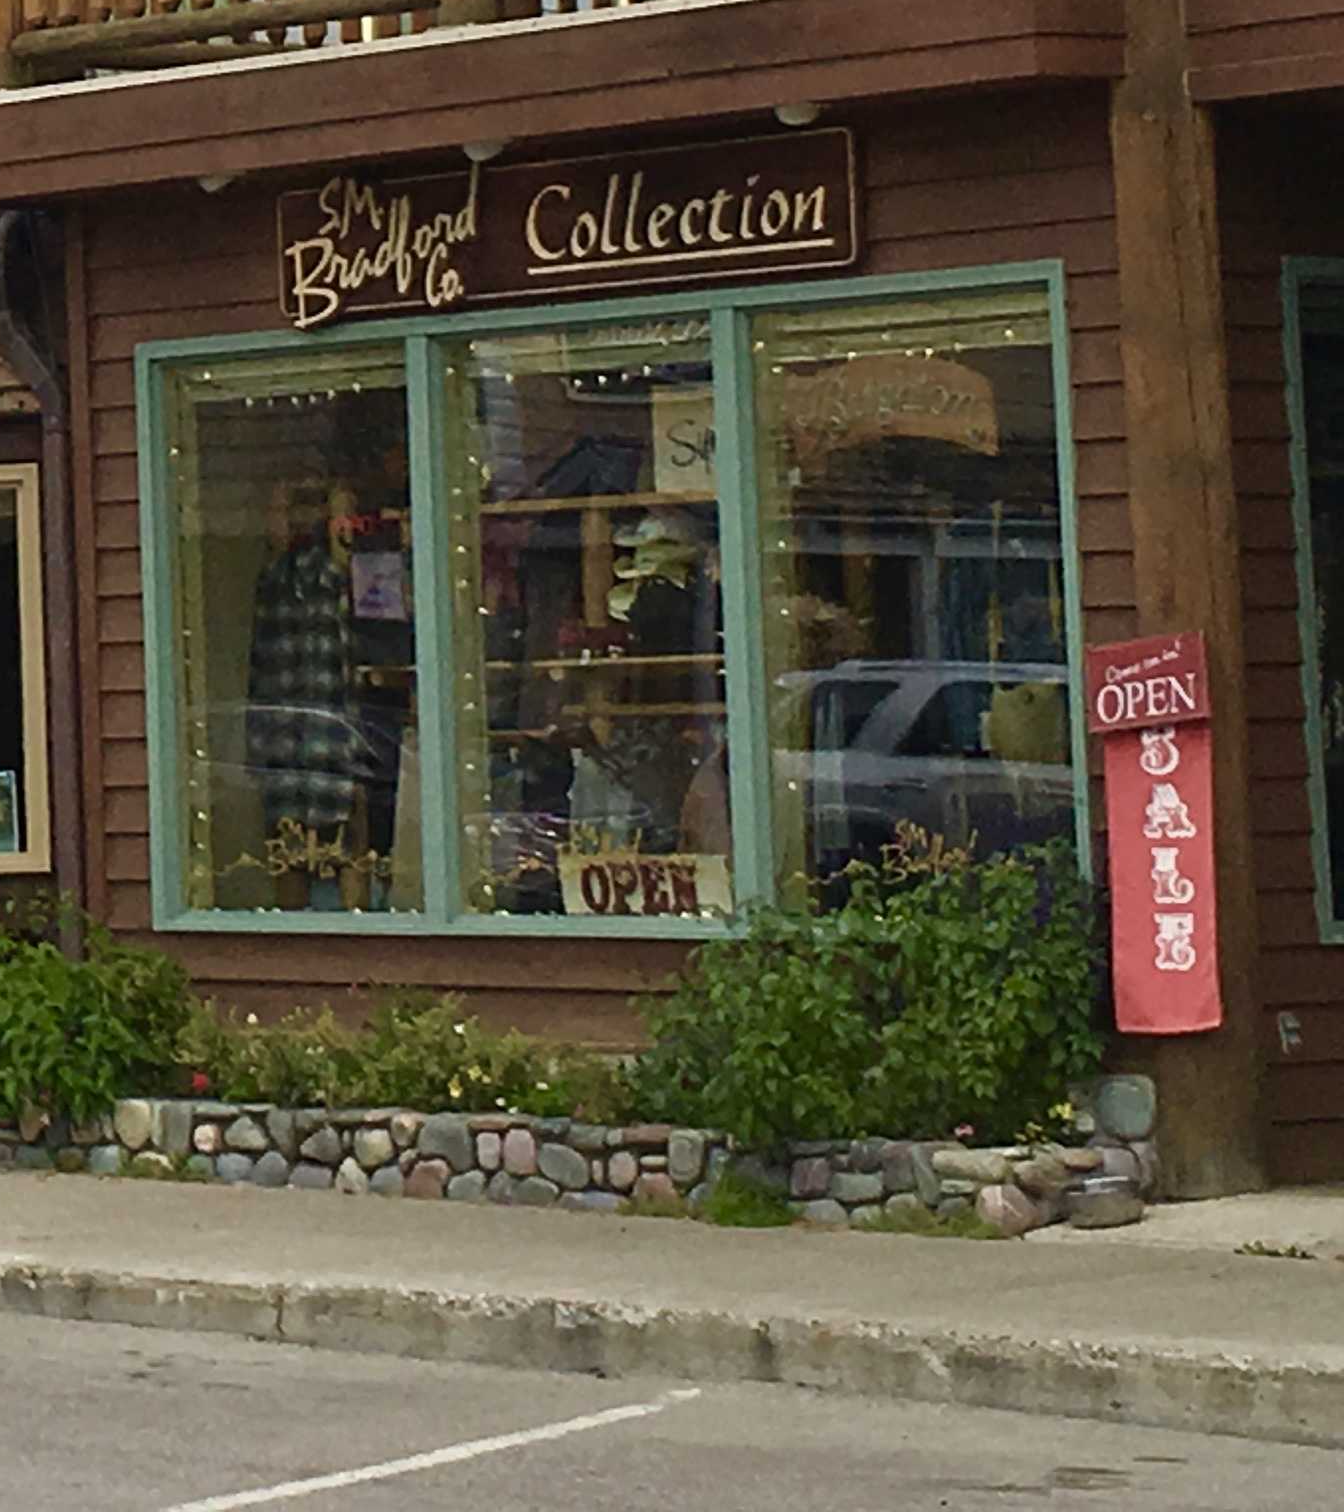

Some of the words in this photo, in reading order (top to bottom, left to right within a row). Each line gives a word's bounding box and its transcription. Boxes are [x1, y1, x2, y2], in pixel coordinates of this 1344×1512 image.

[284, 161, 480, 328] Bradford
[526, 174, 826, 262] Collection
[1096, 674, 1196, 724] OPEN
[580, 859, 699, 916] OPEN
[1139, 726, 1198, 972] SALE
